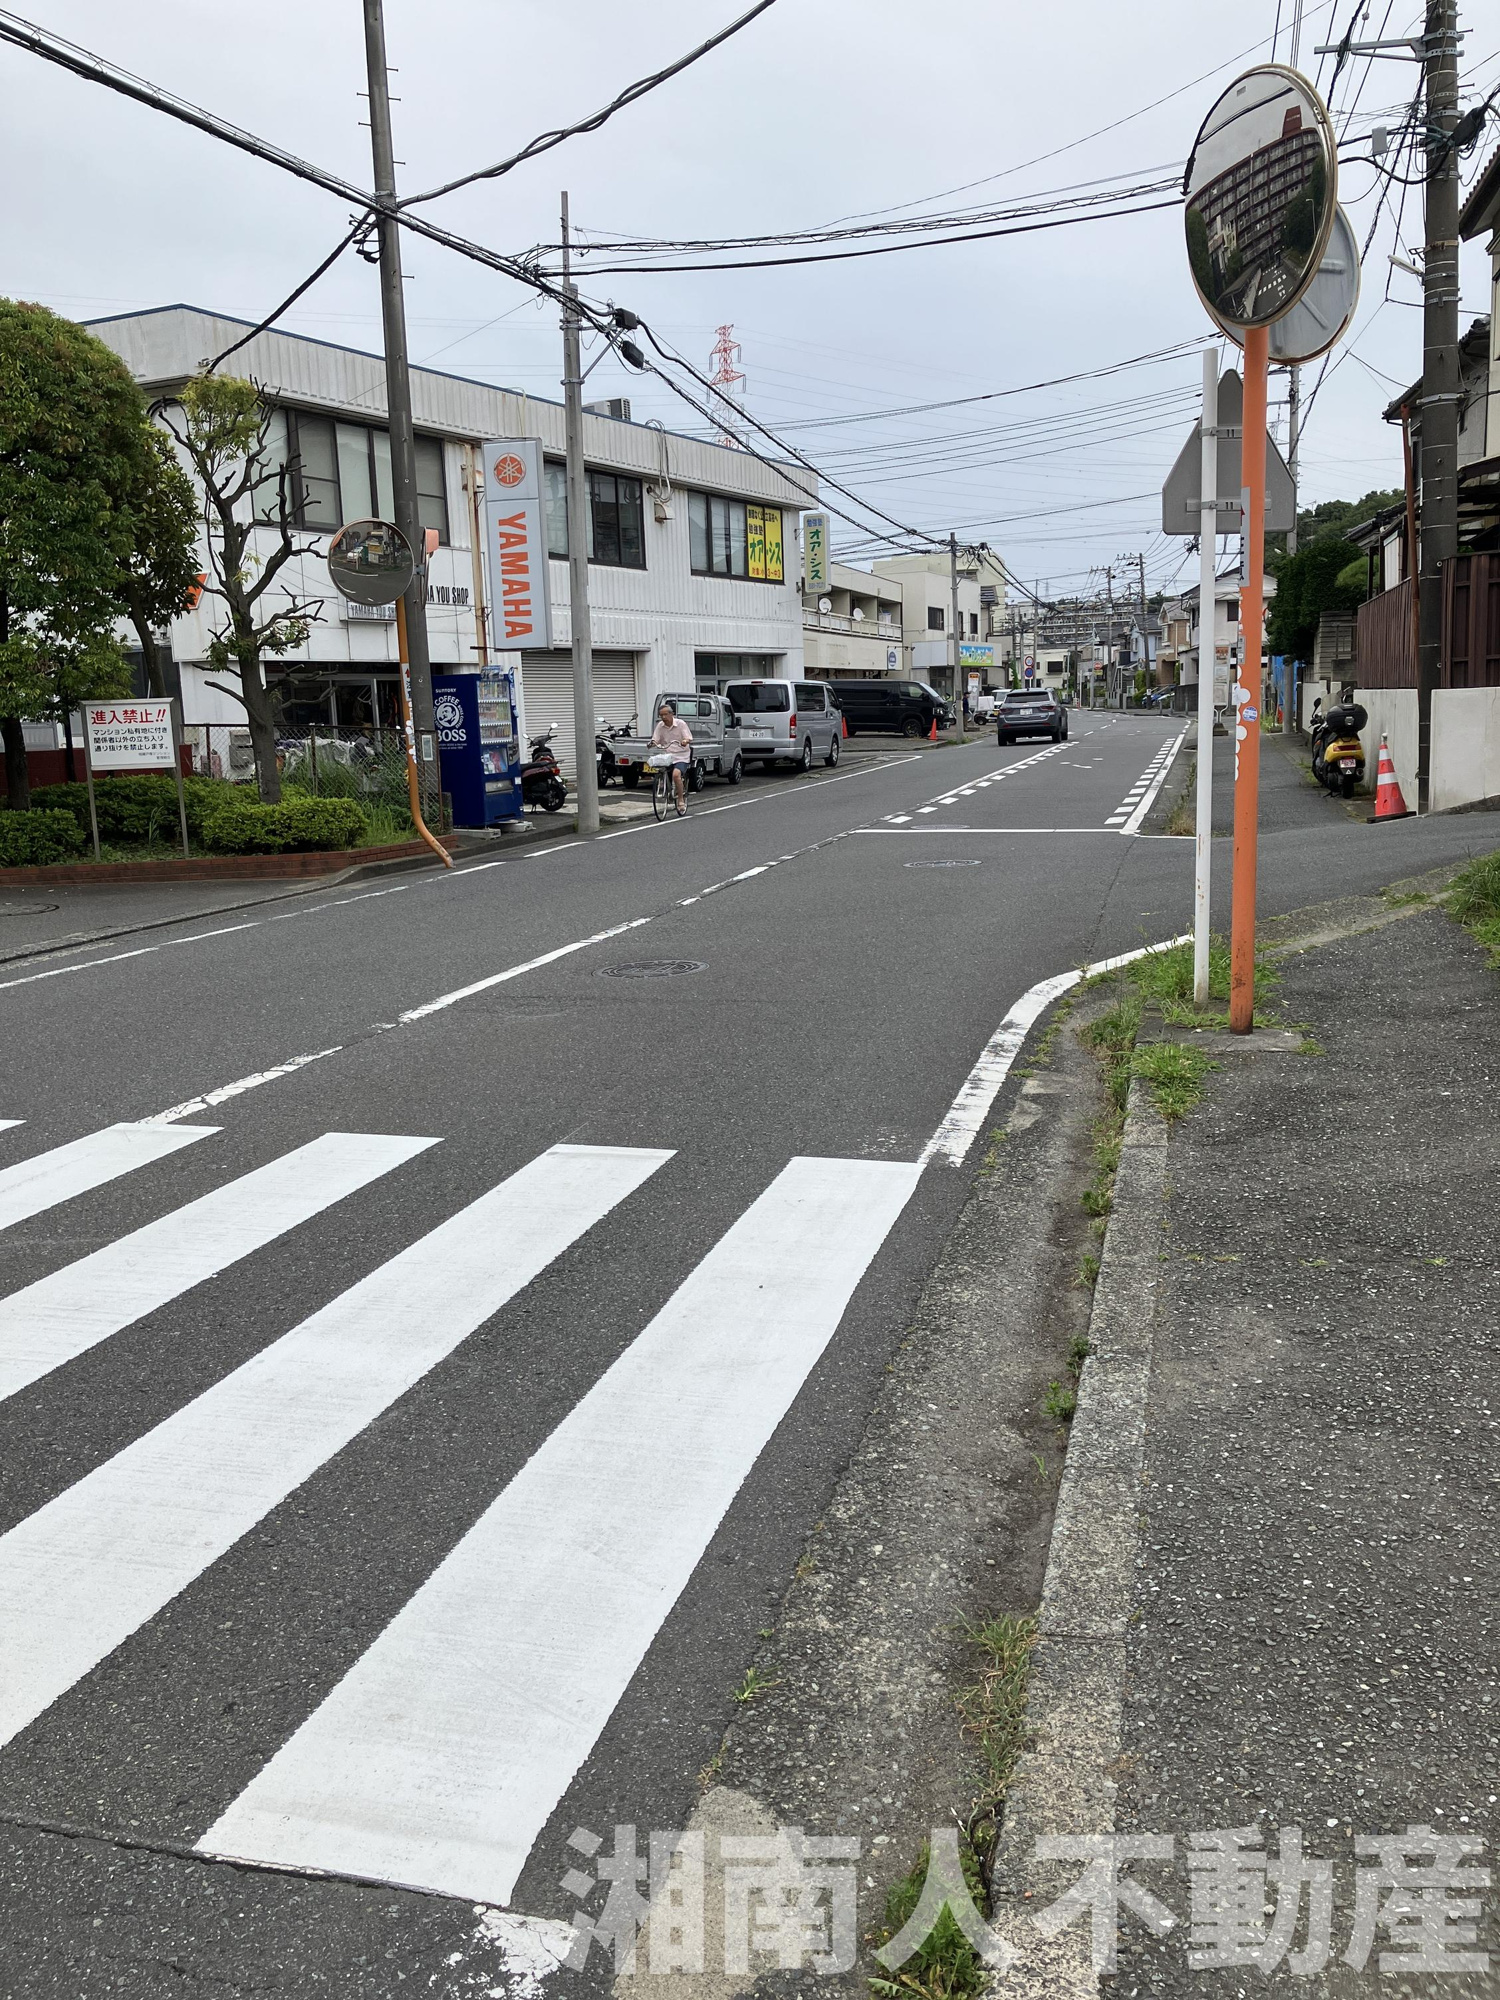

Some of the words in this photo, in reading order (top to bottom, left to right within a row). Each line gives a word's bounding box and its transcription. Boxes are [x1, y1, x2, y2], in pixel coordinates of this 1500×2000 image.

[498, 511, 533, 639] YAMAHA
[435, 586, 450, 603] YOU
[452, 586, 469, 604] SHOP
[350, 604, 374, 617] YAMAHA
[434, 695, 460, 706] COFFEE
[93, 727, 167, 736] マンション私有地に付き
[94, 735, 163, 744] 関係者以外の立ち入り
